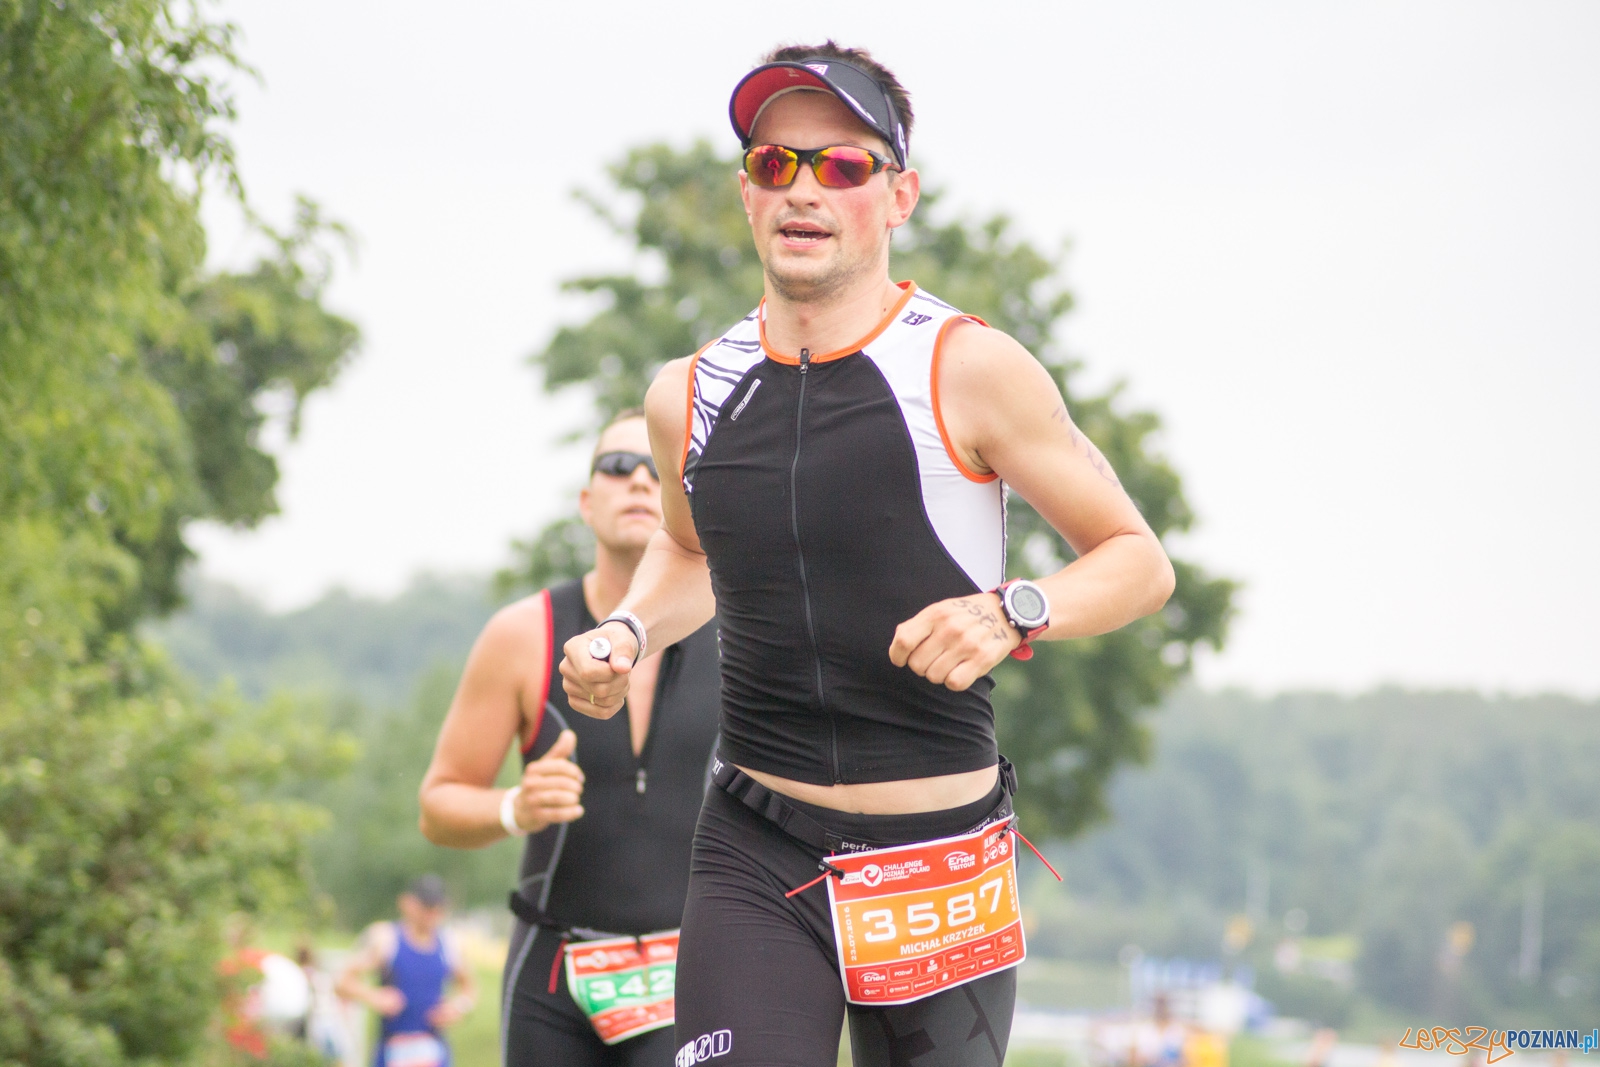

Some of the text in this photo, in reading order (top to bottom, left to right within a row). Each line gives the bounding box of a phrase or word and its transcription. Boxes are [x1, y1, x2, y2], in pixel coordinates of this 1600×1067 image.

[883, 860, 923, 871] CHALLENGE
[948, 854, 975, 866] Enea
[949, 861, 975, 871] TRITOUR
[909, 866, 930, 875] POLAND
[862, 877, 1003, 943] 3587
[844, 906, 857, 961] 23.07.2016
[900, 923, 986, 955] MICHAŁ KRZYŻEK
